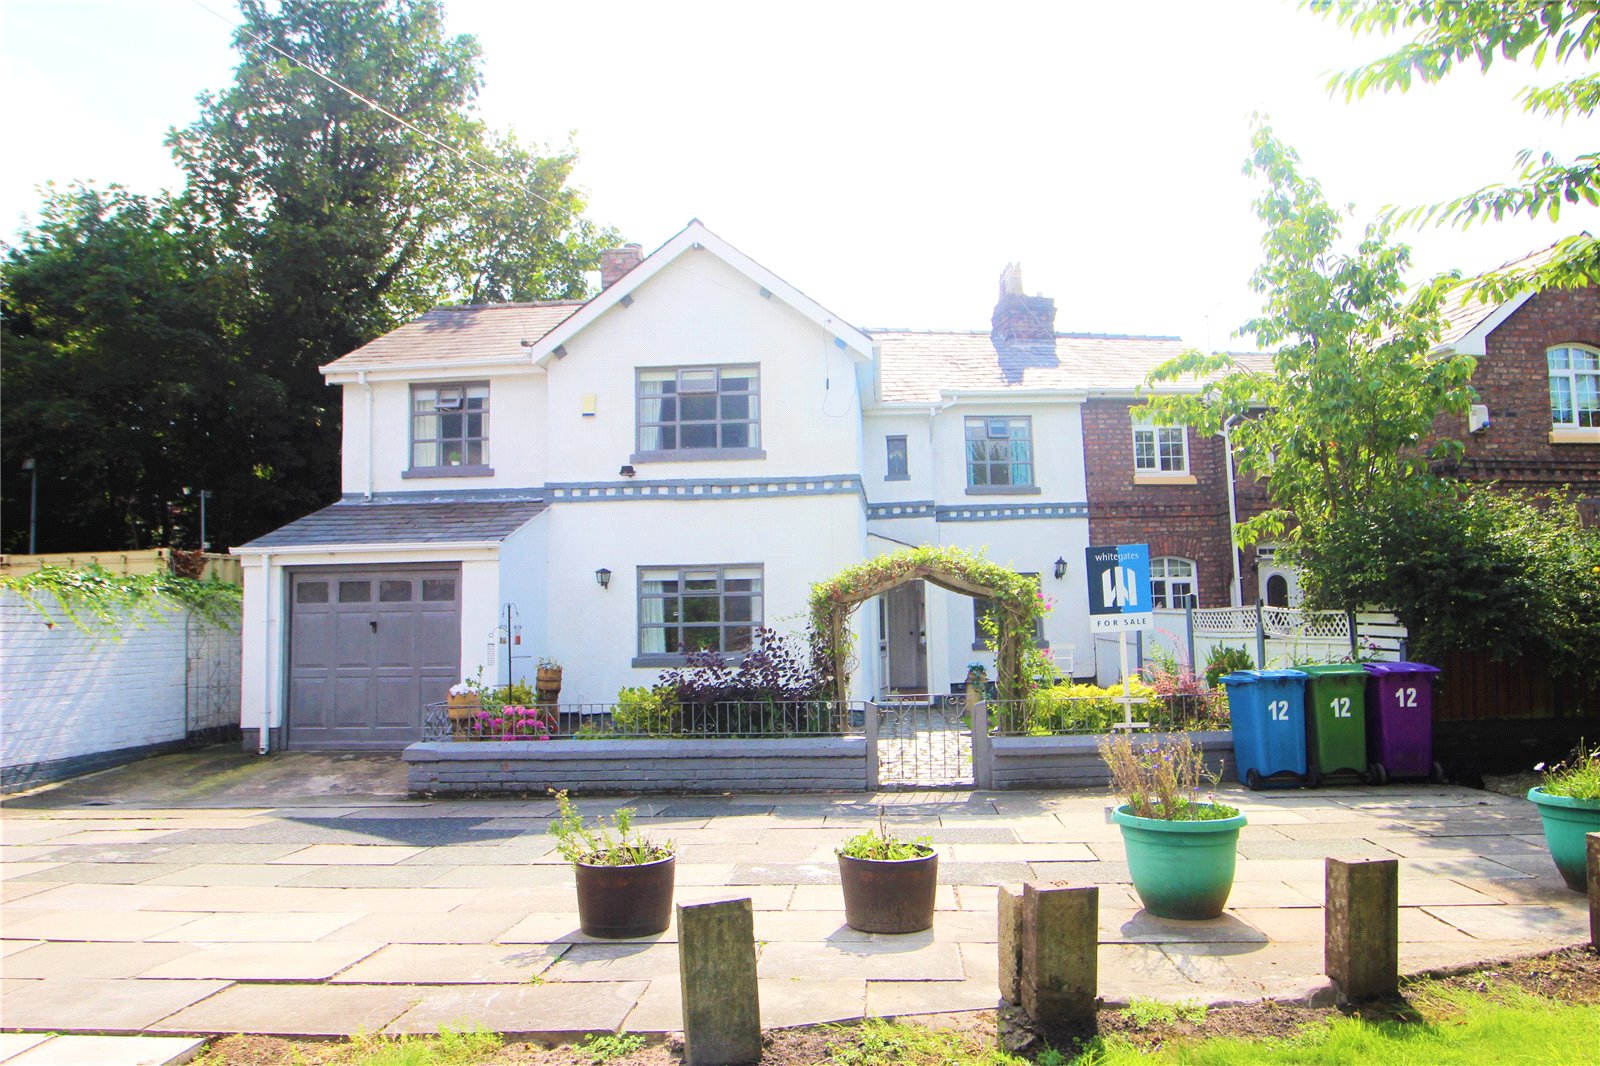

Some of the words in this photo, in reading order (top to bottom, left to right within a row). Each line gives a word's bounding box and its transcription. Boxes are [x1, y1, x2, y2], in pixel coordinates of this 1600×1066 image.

[1095, 552, 1139, 562] whitegates
[1097, 619, 1118, 627] FOR
[1124, 617, 1147, 626] SALE
[1330, 697, 1352, 718] 12
[1395, 687, 1418, 708] 12
[1268, 700, 1289, 721] 12
